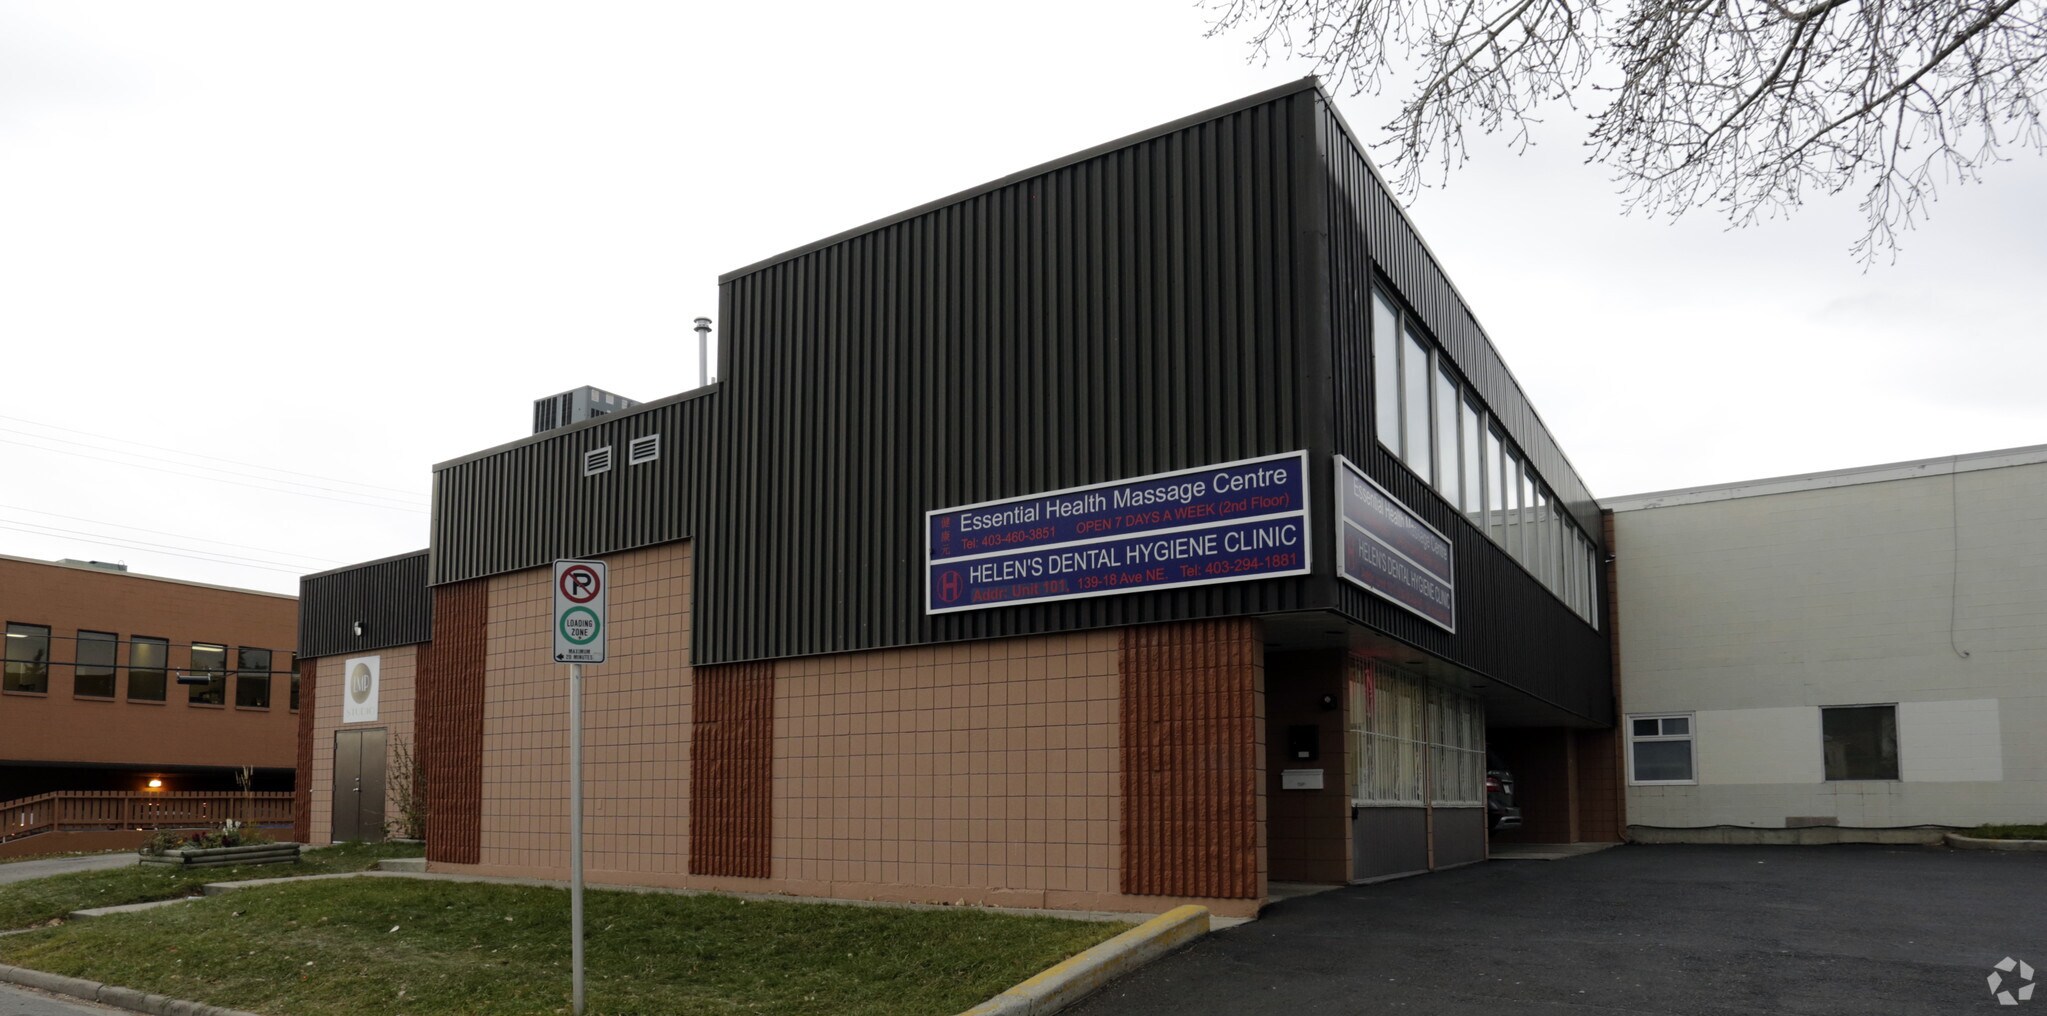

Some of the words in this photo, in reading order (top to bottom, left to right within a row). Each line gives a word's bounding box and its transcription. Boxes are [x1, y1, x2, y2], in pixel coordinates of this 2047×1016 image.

[961, 502, 1040, 532] Essential
[1046, 493, 1106, 519] Health
[1113, 481, 1206, 509] Massage
[1213, 468, 1287, 493] Centre
[962, 539, 979, 549] Tel:
[982, 526, 1056, 547] 403-460-3851
[1076, 519, 1112, 534] OPEN
[1115, 516, 1122, 528] 7
[1126, 510, 1160, 527] DAYS
[1163, 510, 1173, 521] A
[1175, 503, 1216, 519] WEEK
[1219, 500, 1247, 516] (2nd
[1251, 492, 1291, 509] Floor)
[1353, 476, 1384, 515] Essential
[1385, 502, 1403, 529] Health
[970, 557, 1043, 584] HELEN'S
[1048, 548, 1121, 574] DENTAL
[1126, 534, 1218, 565] HYGIENE
[1224, 524, 1297, 552] CLINIC
[972, 587, 1007, 602] Addr:
[1012, 583, 1039, 597] Unit
[1077, 574, 1117, 589] 139-18
[1120, 573, 1142, 584] Ave
[1180, 564, 1201, 577] Tel:
[1205, 553, 1297, 574] 403-294-1881
[1358, 538, 1387, 572] HELEN'S
[1388, 555, 1411, 586] DENTAL
[573, 573, 591, 595] P
[566, 619, 593, 628] LOADING
[571, 628, 588, 636] ZONE
